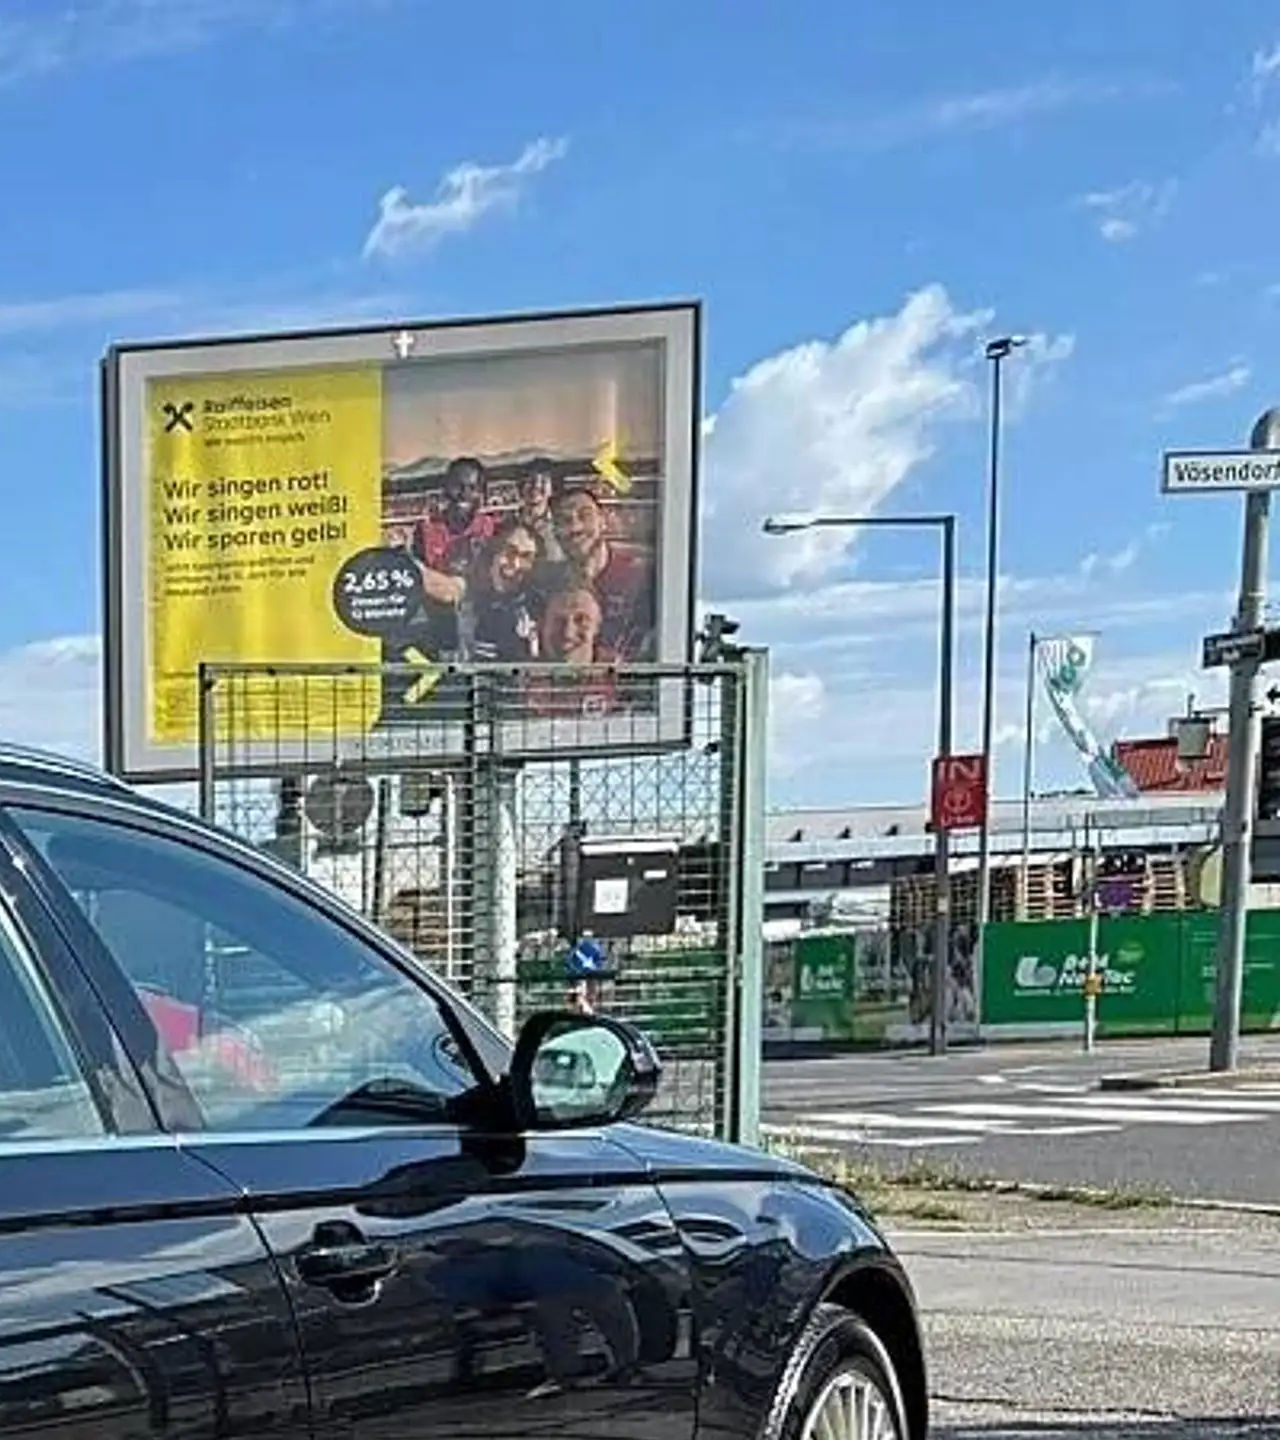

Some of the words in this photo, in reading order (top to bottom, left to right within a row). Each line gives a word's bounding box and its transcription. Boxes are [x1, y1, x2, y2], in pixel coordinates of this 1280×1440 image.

[163, 479, 201, 499] Wir
[207, 476, 282, 501] singen
[287, 470, 328, 491] rot!
[163, 506, 201, 525] Wir
[207, 502, 282, 526] singen
[288, 495, 347, 517] weiß!
[163, 530, 201, 551] Wir
[207, 528, 286, 550] sparen
[291, 521, 347, 548] gelb!
